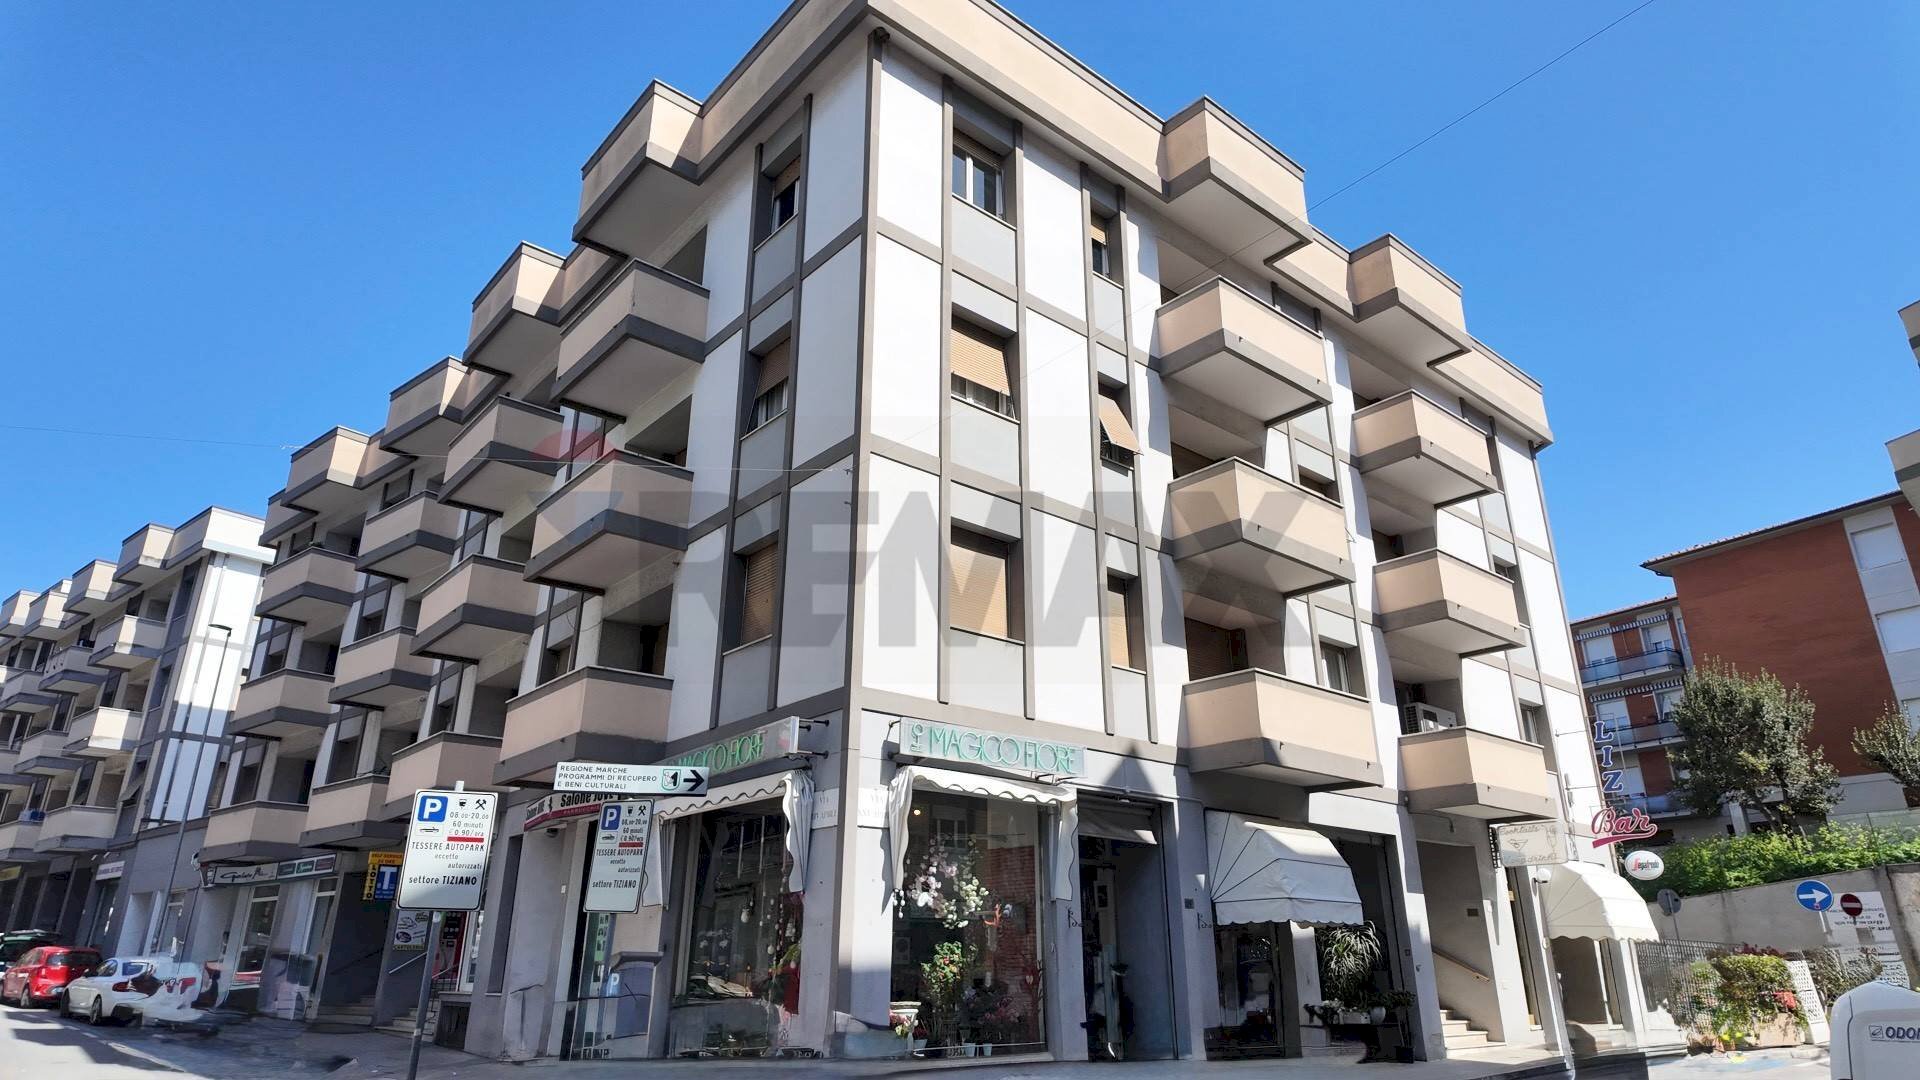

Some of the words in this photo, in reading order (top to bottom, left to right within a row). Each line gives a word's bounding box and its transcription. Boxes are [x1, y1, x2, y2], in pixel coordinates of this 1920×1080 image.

[928, 725, 1020, 766] MAGICO
[1023, 741, 1077, 775] FIORE
[560, 765, 593, 773] REGIONE
[596, 766, 628, 774] MARCHE
[558, 773, 605, 781] PROGRAMMI
[560, 792, 592, 807] Salone
[423, 798, 442, 819] P
[604, 808, 617, 828] P
[452, 820, 462, 828] 60
[1591, 808, 1658, 847] Bar
[411, 841, 443, 851] TESSERE
[445, 843, 485, 852] AUTOPARK
[596, 848, 617, 857] TESSERE
[617, 848, 643, 857] AUTOPARK
[447, 862, 483, 870] autorizzati
[409, 875, 440, 884] settore
[442, 875, 477, 886] TIZIANO
[592, 879, 612, 888] settore
[613, 879, 637, 889] TIZIANO
